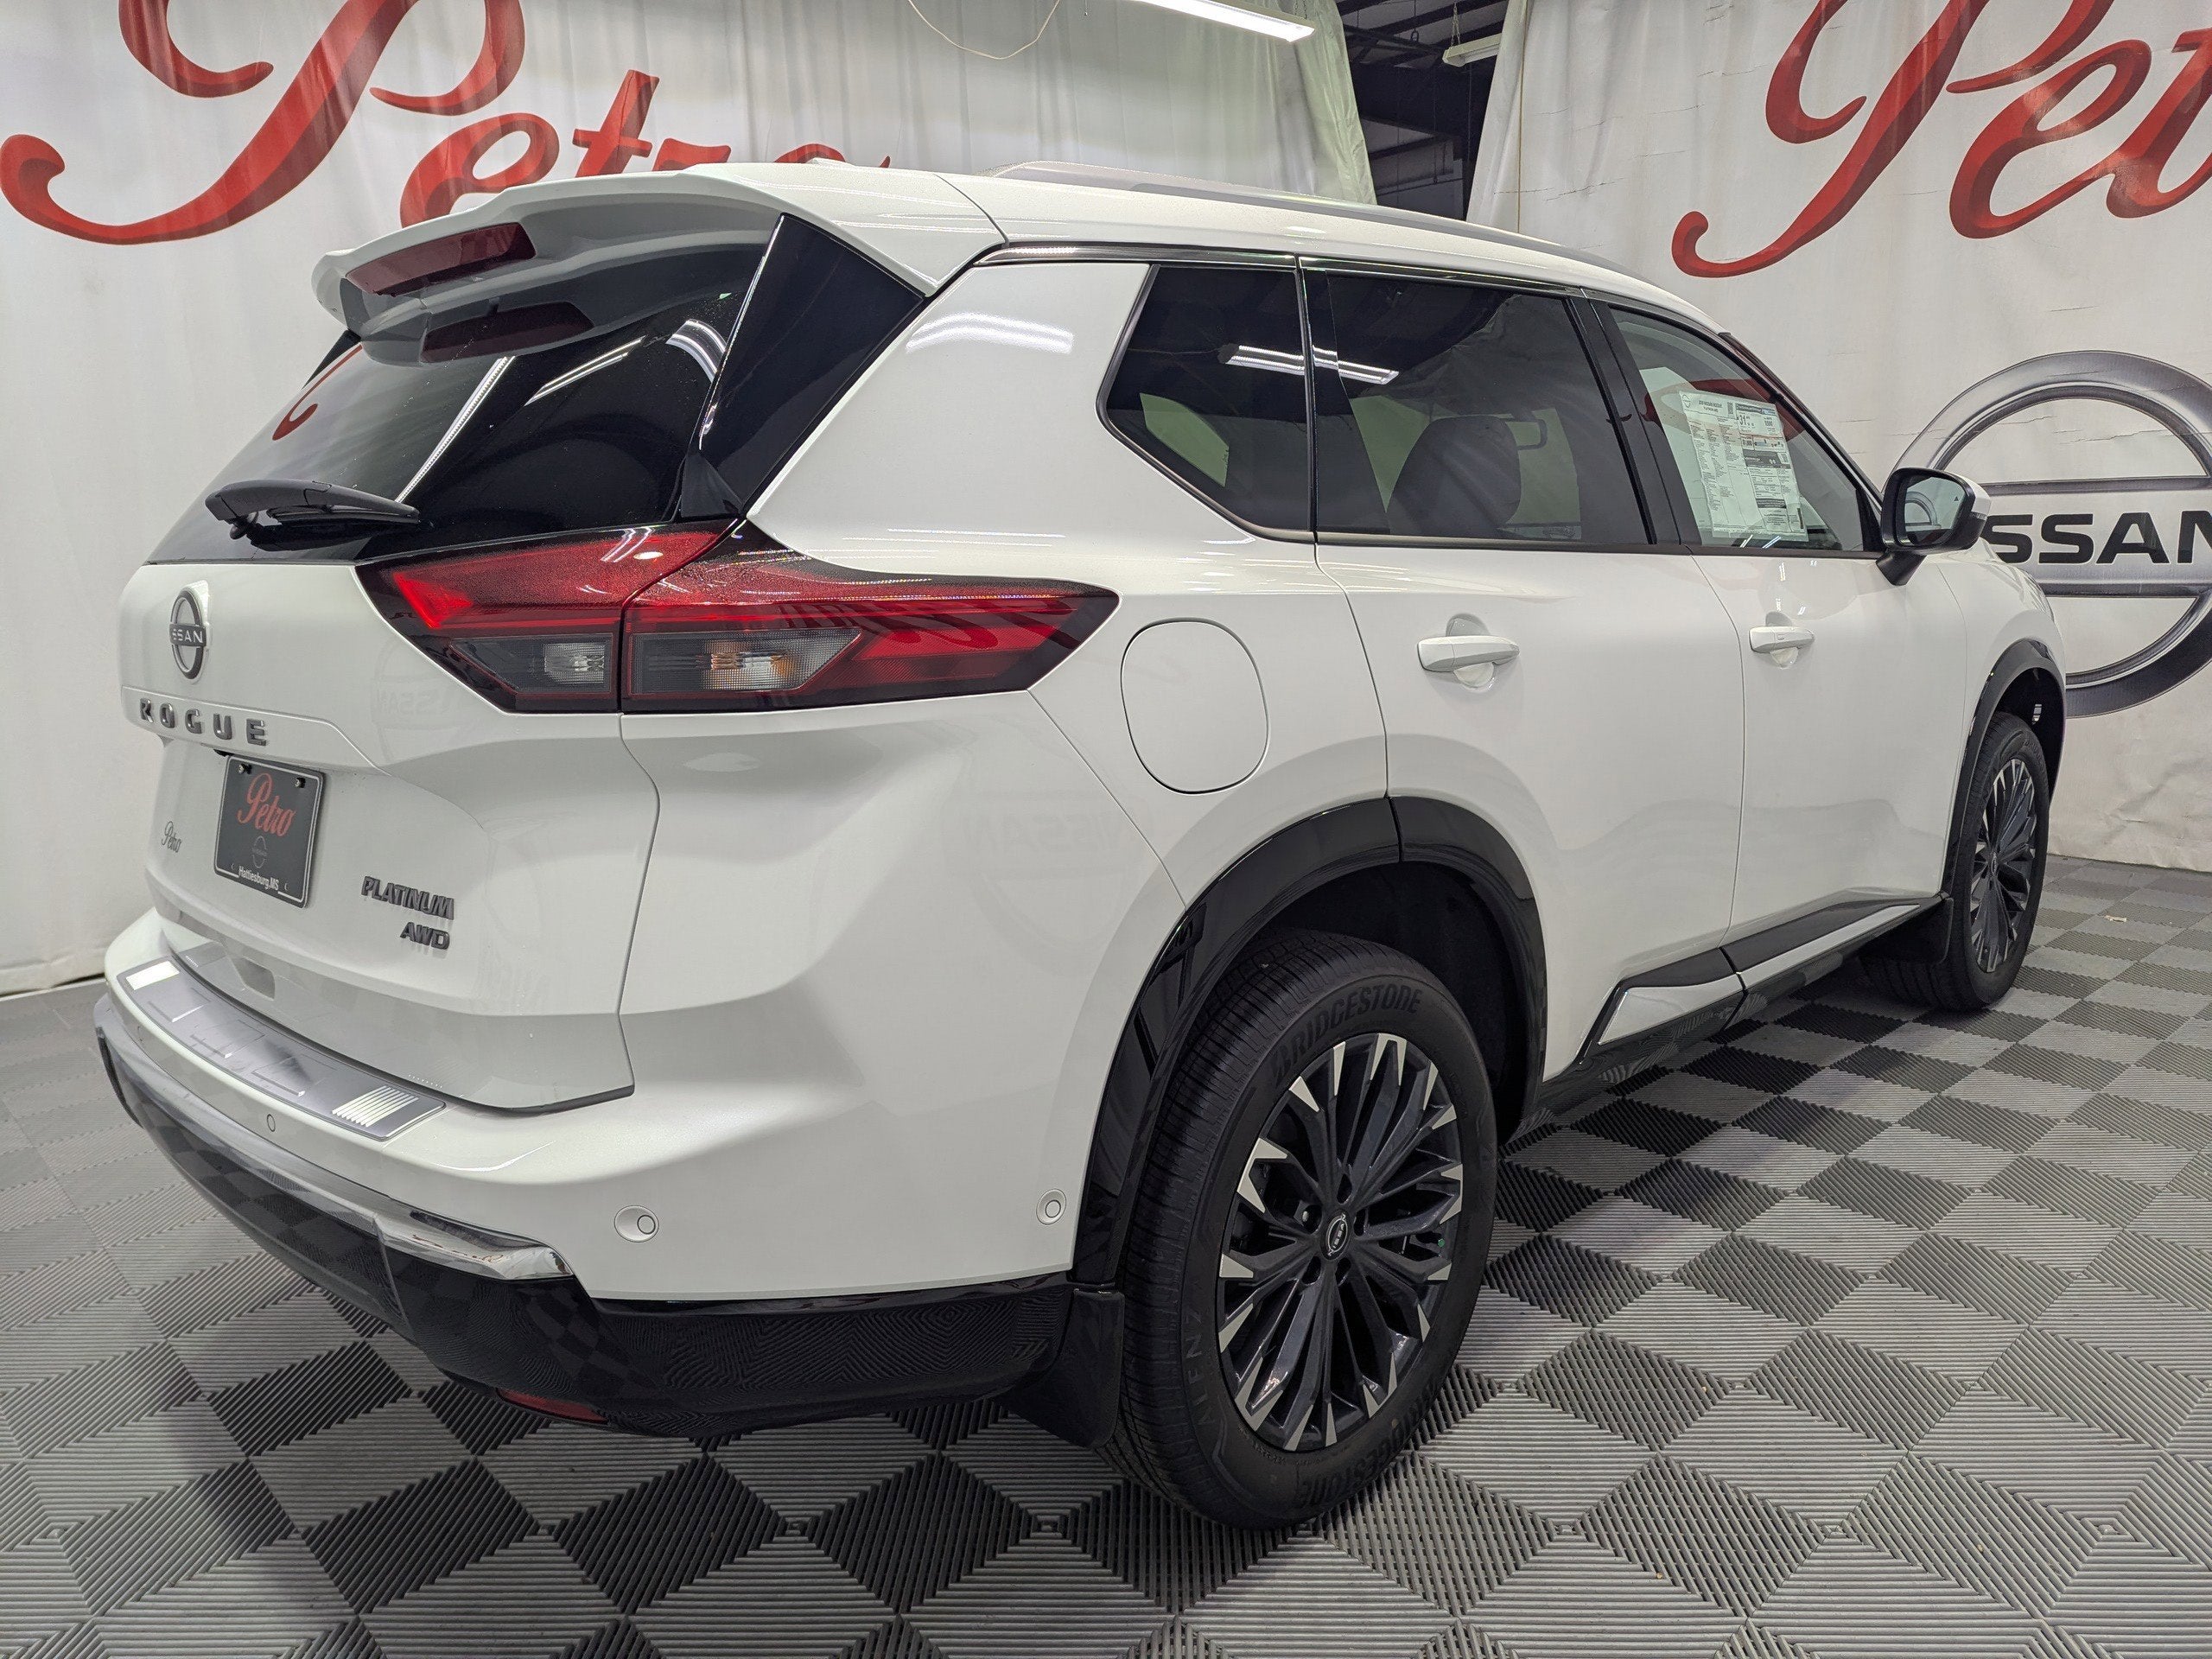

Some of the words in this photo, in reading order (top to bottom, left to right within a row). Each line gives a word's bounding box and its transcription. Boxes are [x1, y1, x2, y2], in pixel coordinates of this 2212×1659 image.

[0, 0, 890, 245] Pet
[1671, 0, 2212, 278] Pet
[1980, 510, 2212, 564] SSAN
[172, 628, 203, 644] SSAN
[140, 697, 267, 747] ROGUE
[236, 772, 297, 837] Petro
[161, 821, 182, 853] Petro
[361, 875, 454, 921] PLATINUM
[399, 921, 450, 950] AWD
[1268, 982, 1424, 1088] BRIDGESTONE
